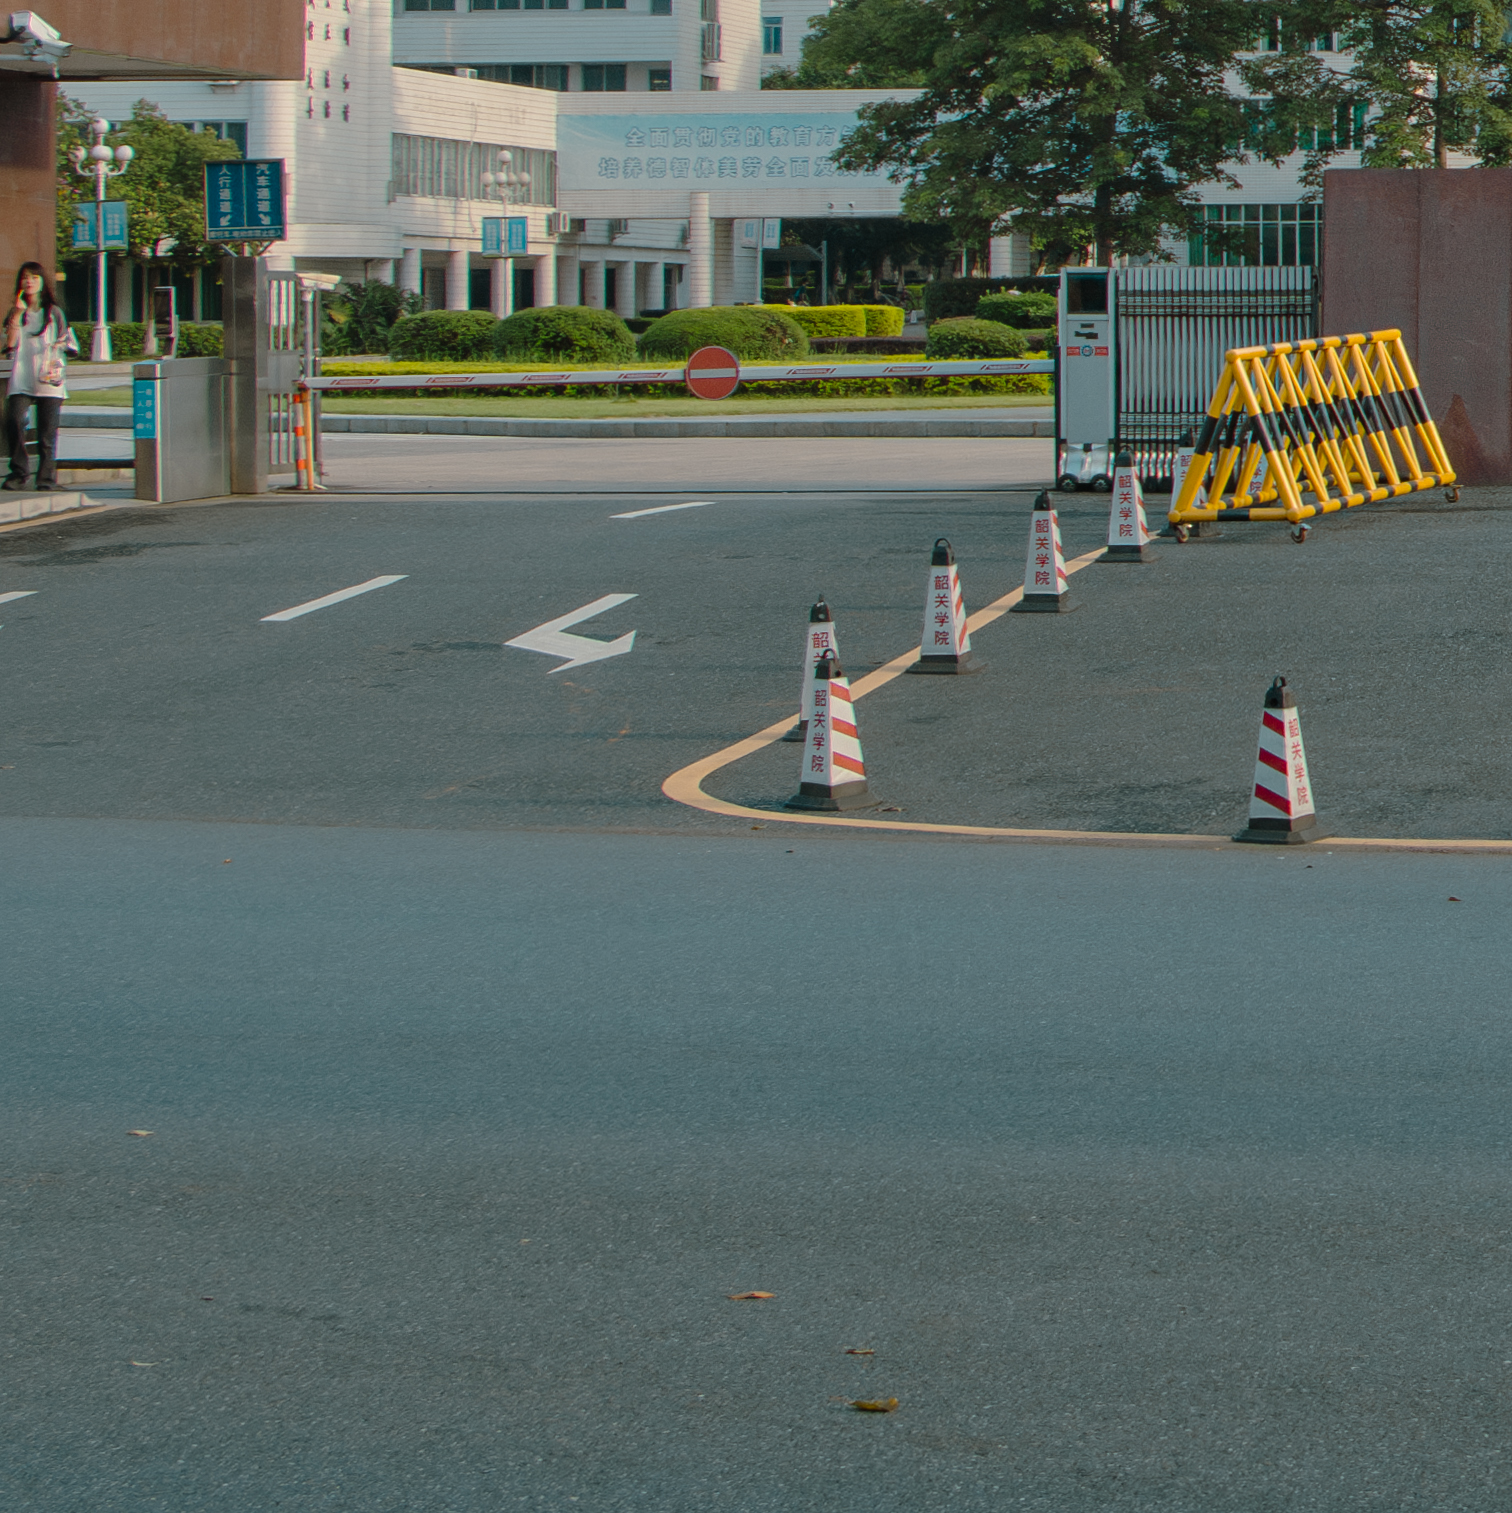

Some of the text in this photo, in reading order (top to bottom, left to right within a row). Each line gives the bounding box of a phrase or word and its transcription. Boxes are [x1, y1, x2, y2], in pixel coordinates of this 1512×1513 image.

[1118, 475, 1133, 537] 韶关学院
[1035, 519, 1050, 585] 韶关学院
[934, 575, 949, 646] 韶关学院
[811, 689, 827, 772] 韶关学院
